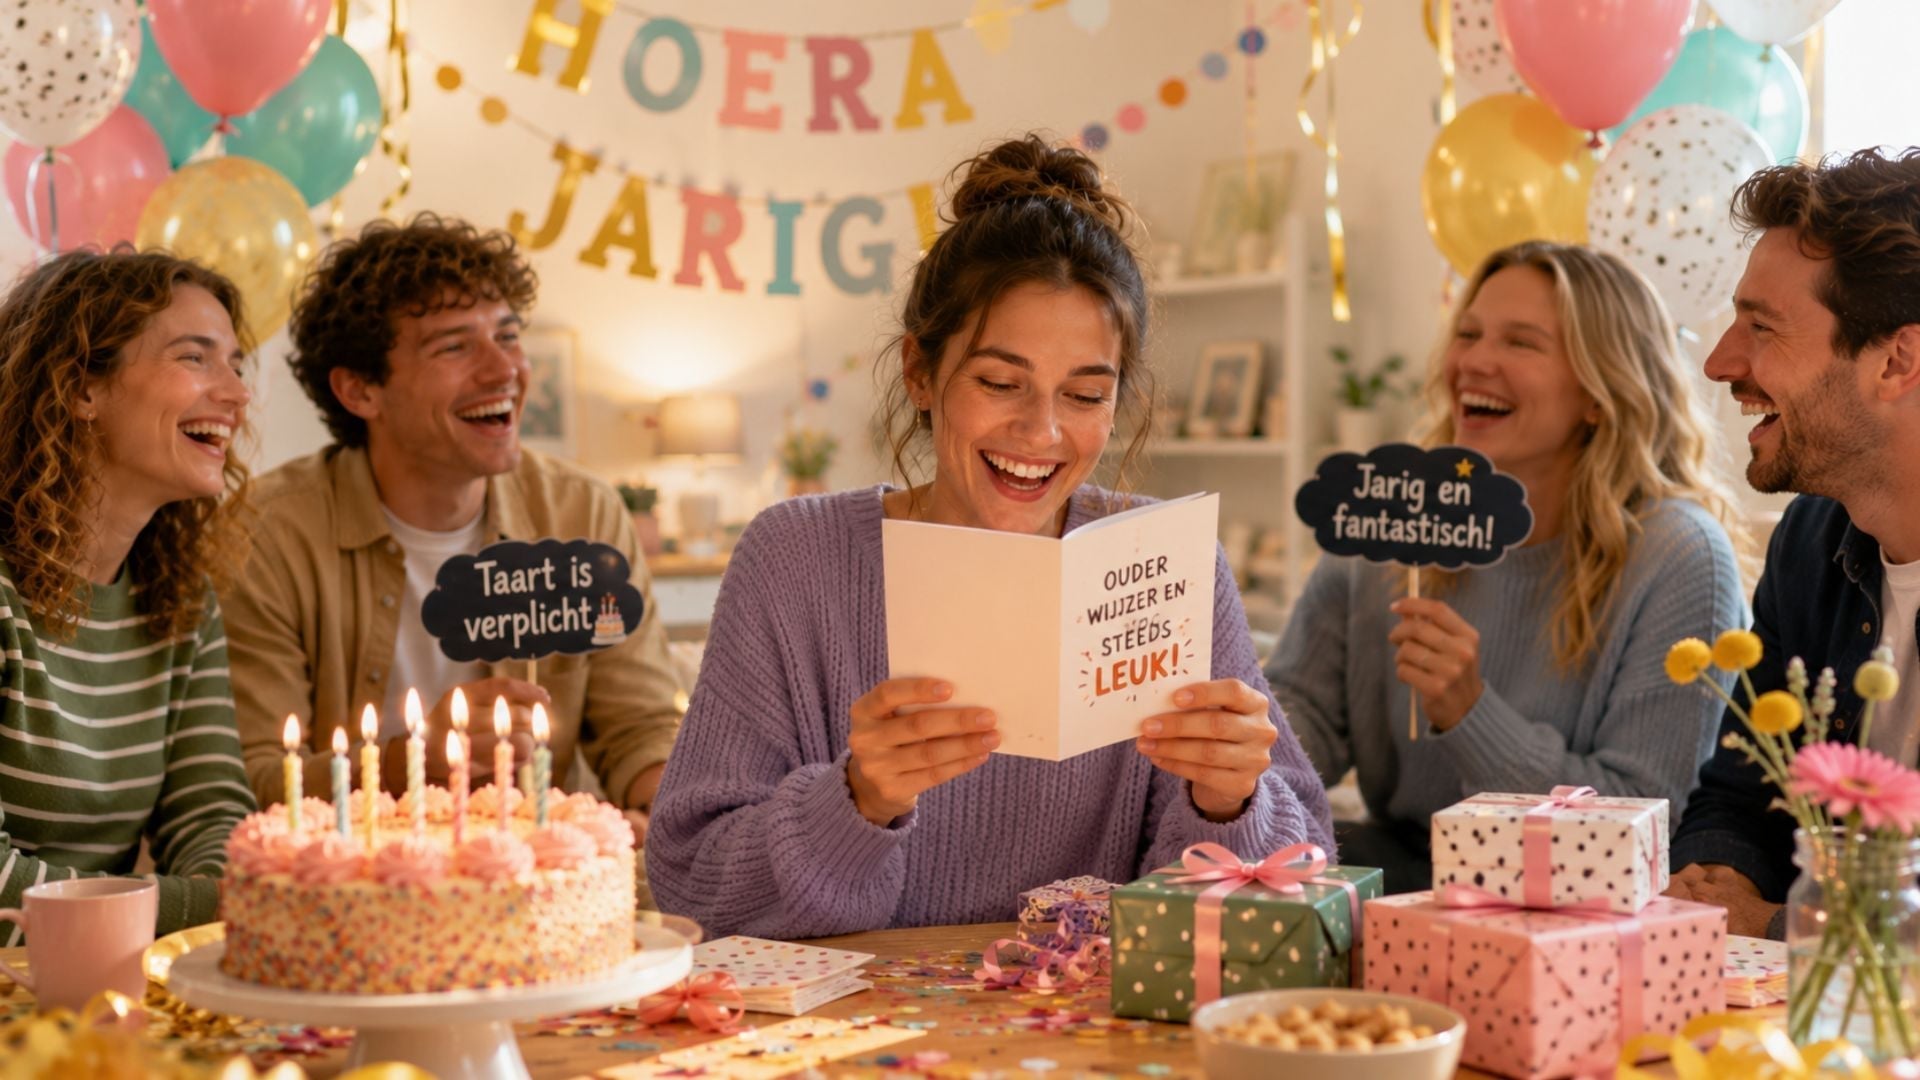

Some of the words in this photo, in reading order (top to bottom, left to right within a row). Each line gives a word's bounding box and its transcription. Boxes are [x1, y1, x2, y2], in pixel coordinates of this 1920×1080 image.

[506, 0, 974, 132] HOERA
[1353, 463, 1426, 514] Jarig
[1438, 481, 1471, 506] en
[1332, 502, 1495, 550] fantastisch!
[474, 558, 556, 597] Taart
[570, 556, 593, 588] is
[1104, 555, 1168, 591] OUDER
[1164, 579, 1187, 601] EN
[463, 596, 593, 649] verplicht
[1101, 619, 1172, 657] STEEDS
[1095, 643, 1179, 697] LEUK!
